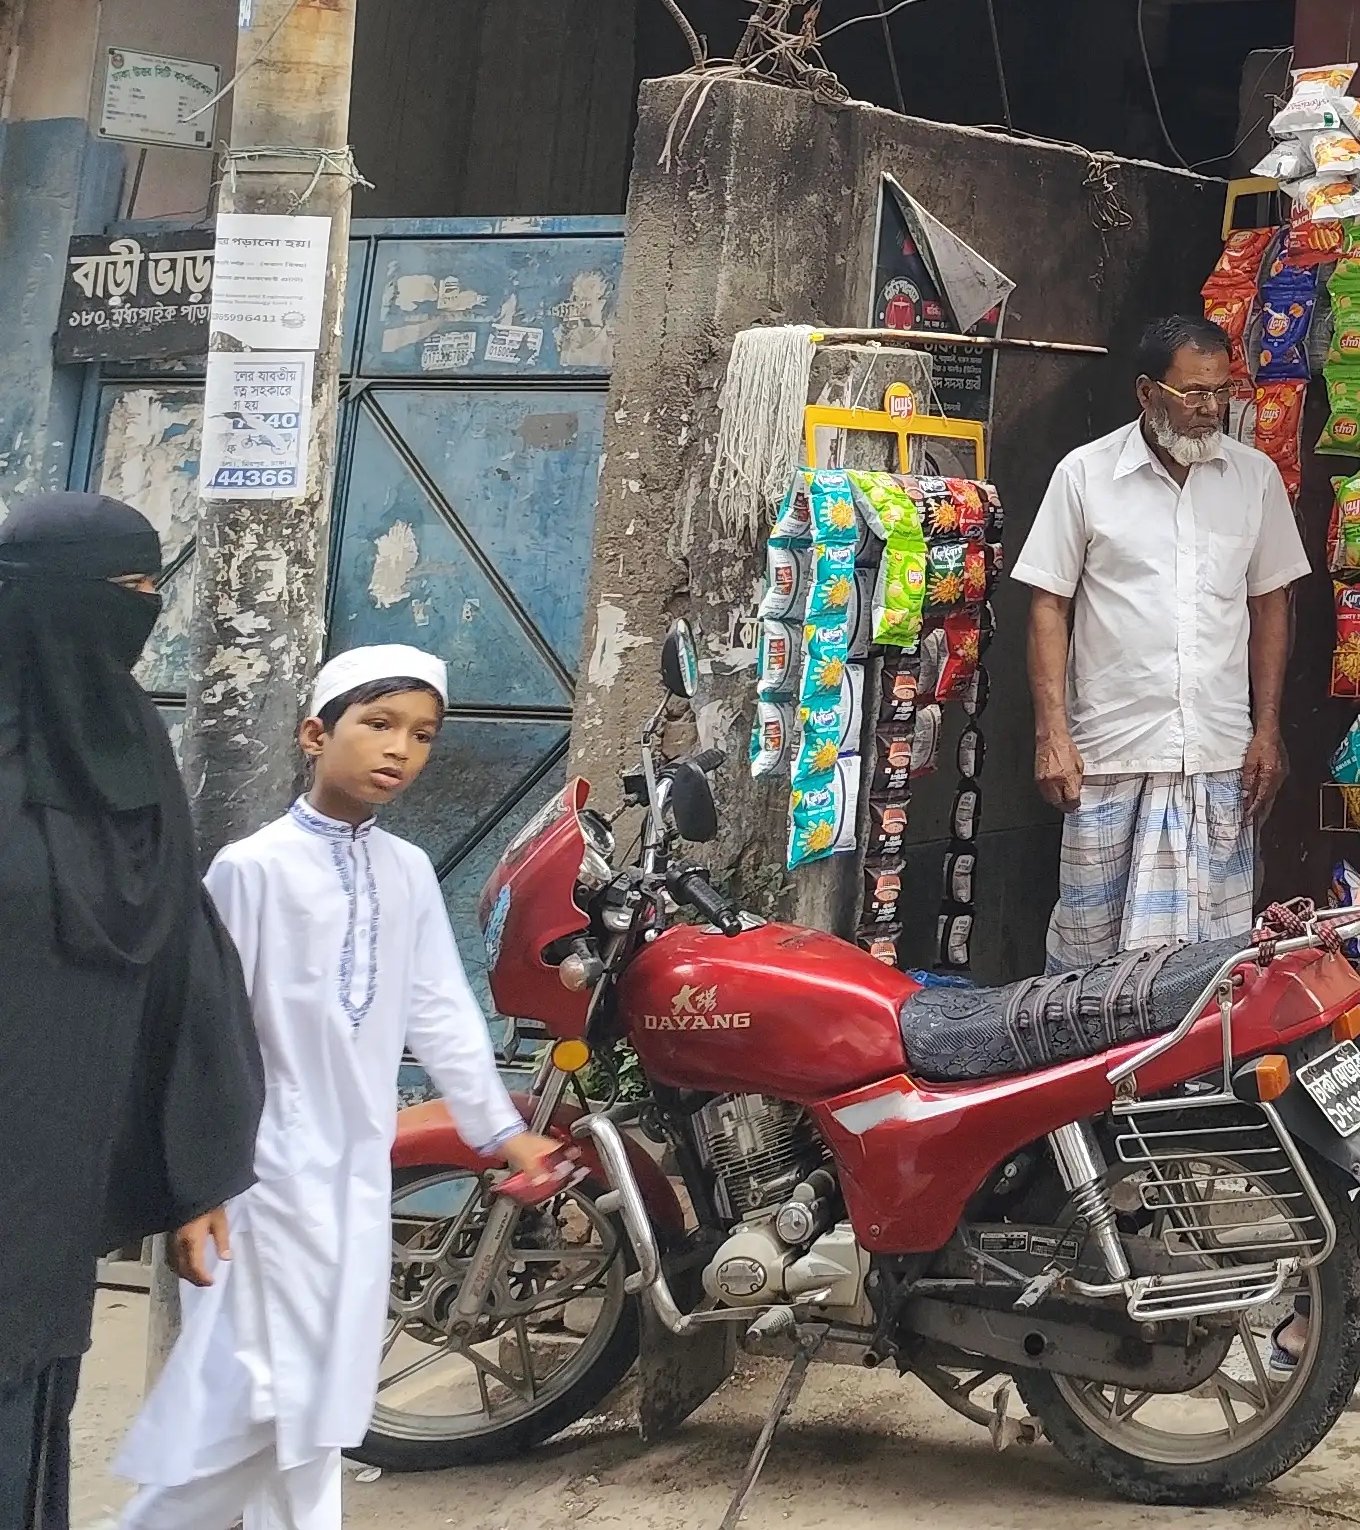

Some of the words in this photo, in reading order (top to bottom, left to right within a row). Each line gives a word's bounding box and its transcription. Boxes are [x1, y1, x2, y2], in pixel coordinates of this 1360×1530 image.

[70, 238, 145, 307] বাড়ী
[148, 249, 216, 304] ভাড়
[233, 370, 255, 382] লের
[644, 1012, 751, 1030] DAYANG
